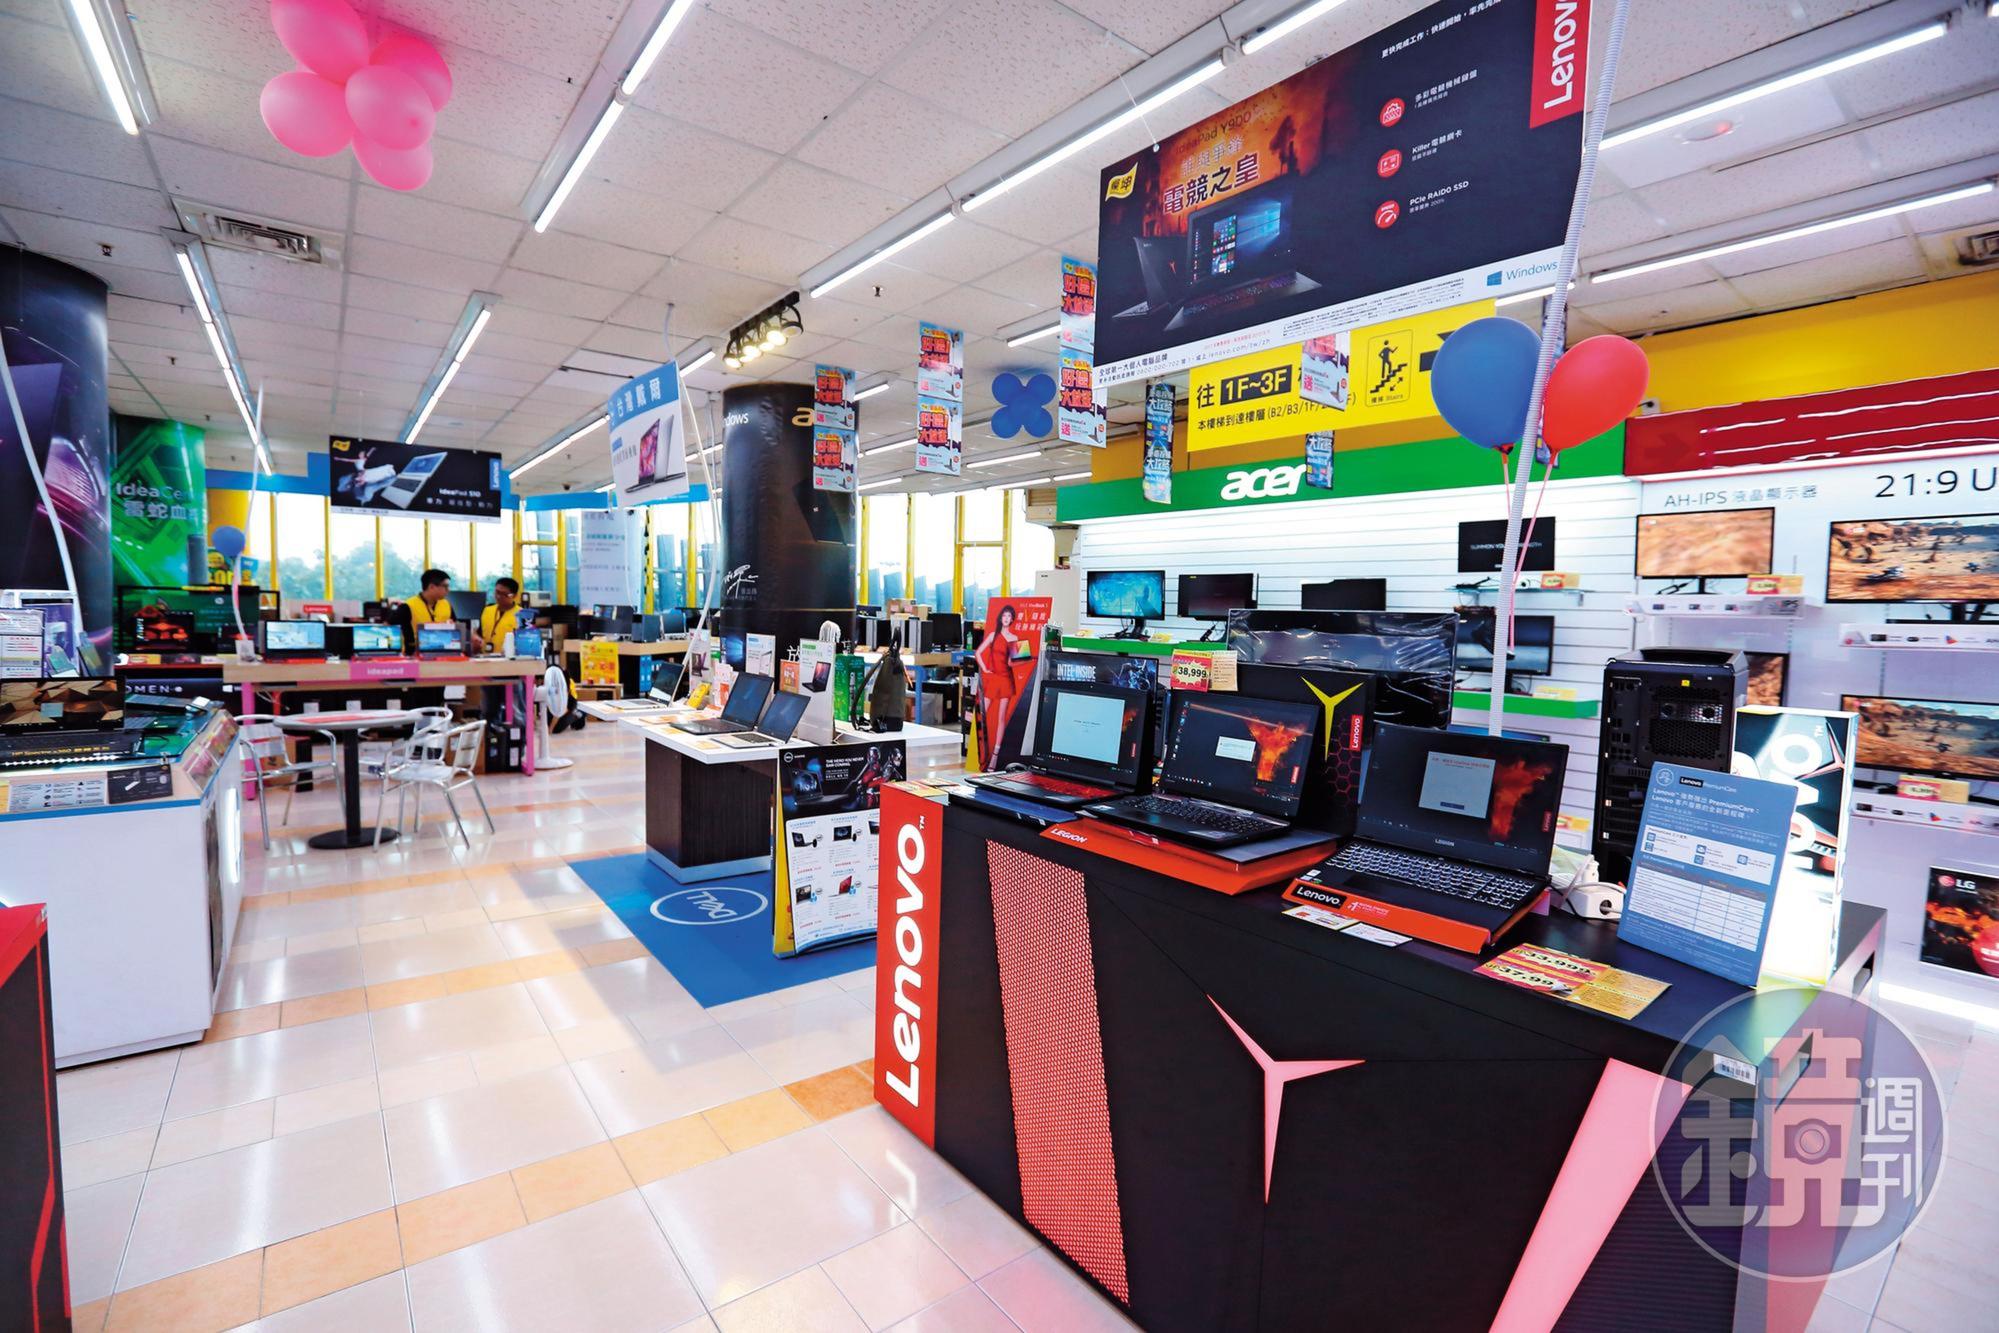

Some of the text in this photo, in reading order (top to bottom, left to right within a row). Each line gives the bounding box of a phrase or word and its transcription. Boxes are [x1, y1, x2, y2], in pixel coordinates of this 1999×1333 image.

[1544, 0, 1577, 109] Lenov
[1164, 152, 1259, 213] 電競之皇
[1453, 181, 1469, 191] SSD
[1506, 261, 1558, 280] Windows
[1196, 384, 1215, 409] 往
[1224, 368, 1289, 401] 1F~3F
[1220, 464, 1306, 501] acer
[1875, 470, 1958, 497] 21:9
[1664, 490, 1728, 507] AH-IPS
[1352, 718, 1360, 748] Lenovo
[1681, 777, 1702, 787] Lenovo
[1050, 828, 1088, 843] LEGION
[1296, 886, 1341, 905] Lenovo
[1956, 879, 1976, 890] LG
[886, 823, 926, 1108] Lenovo
[1499, 965, 1555, 988] 37,99
